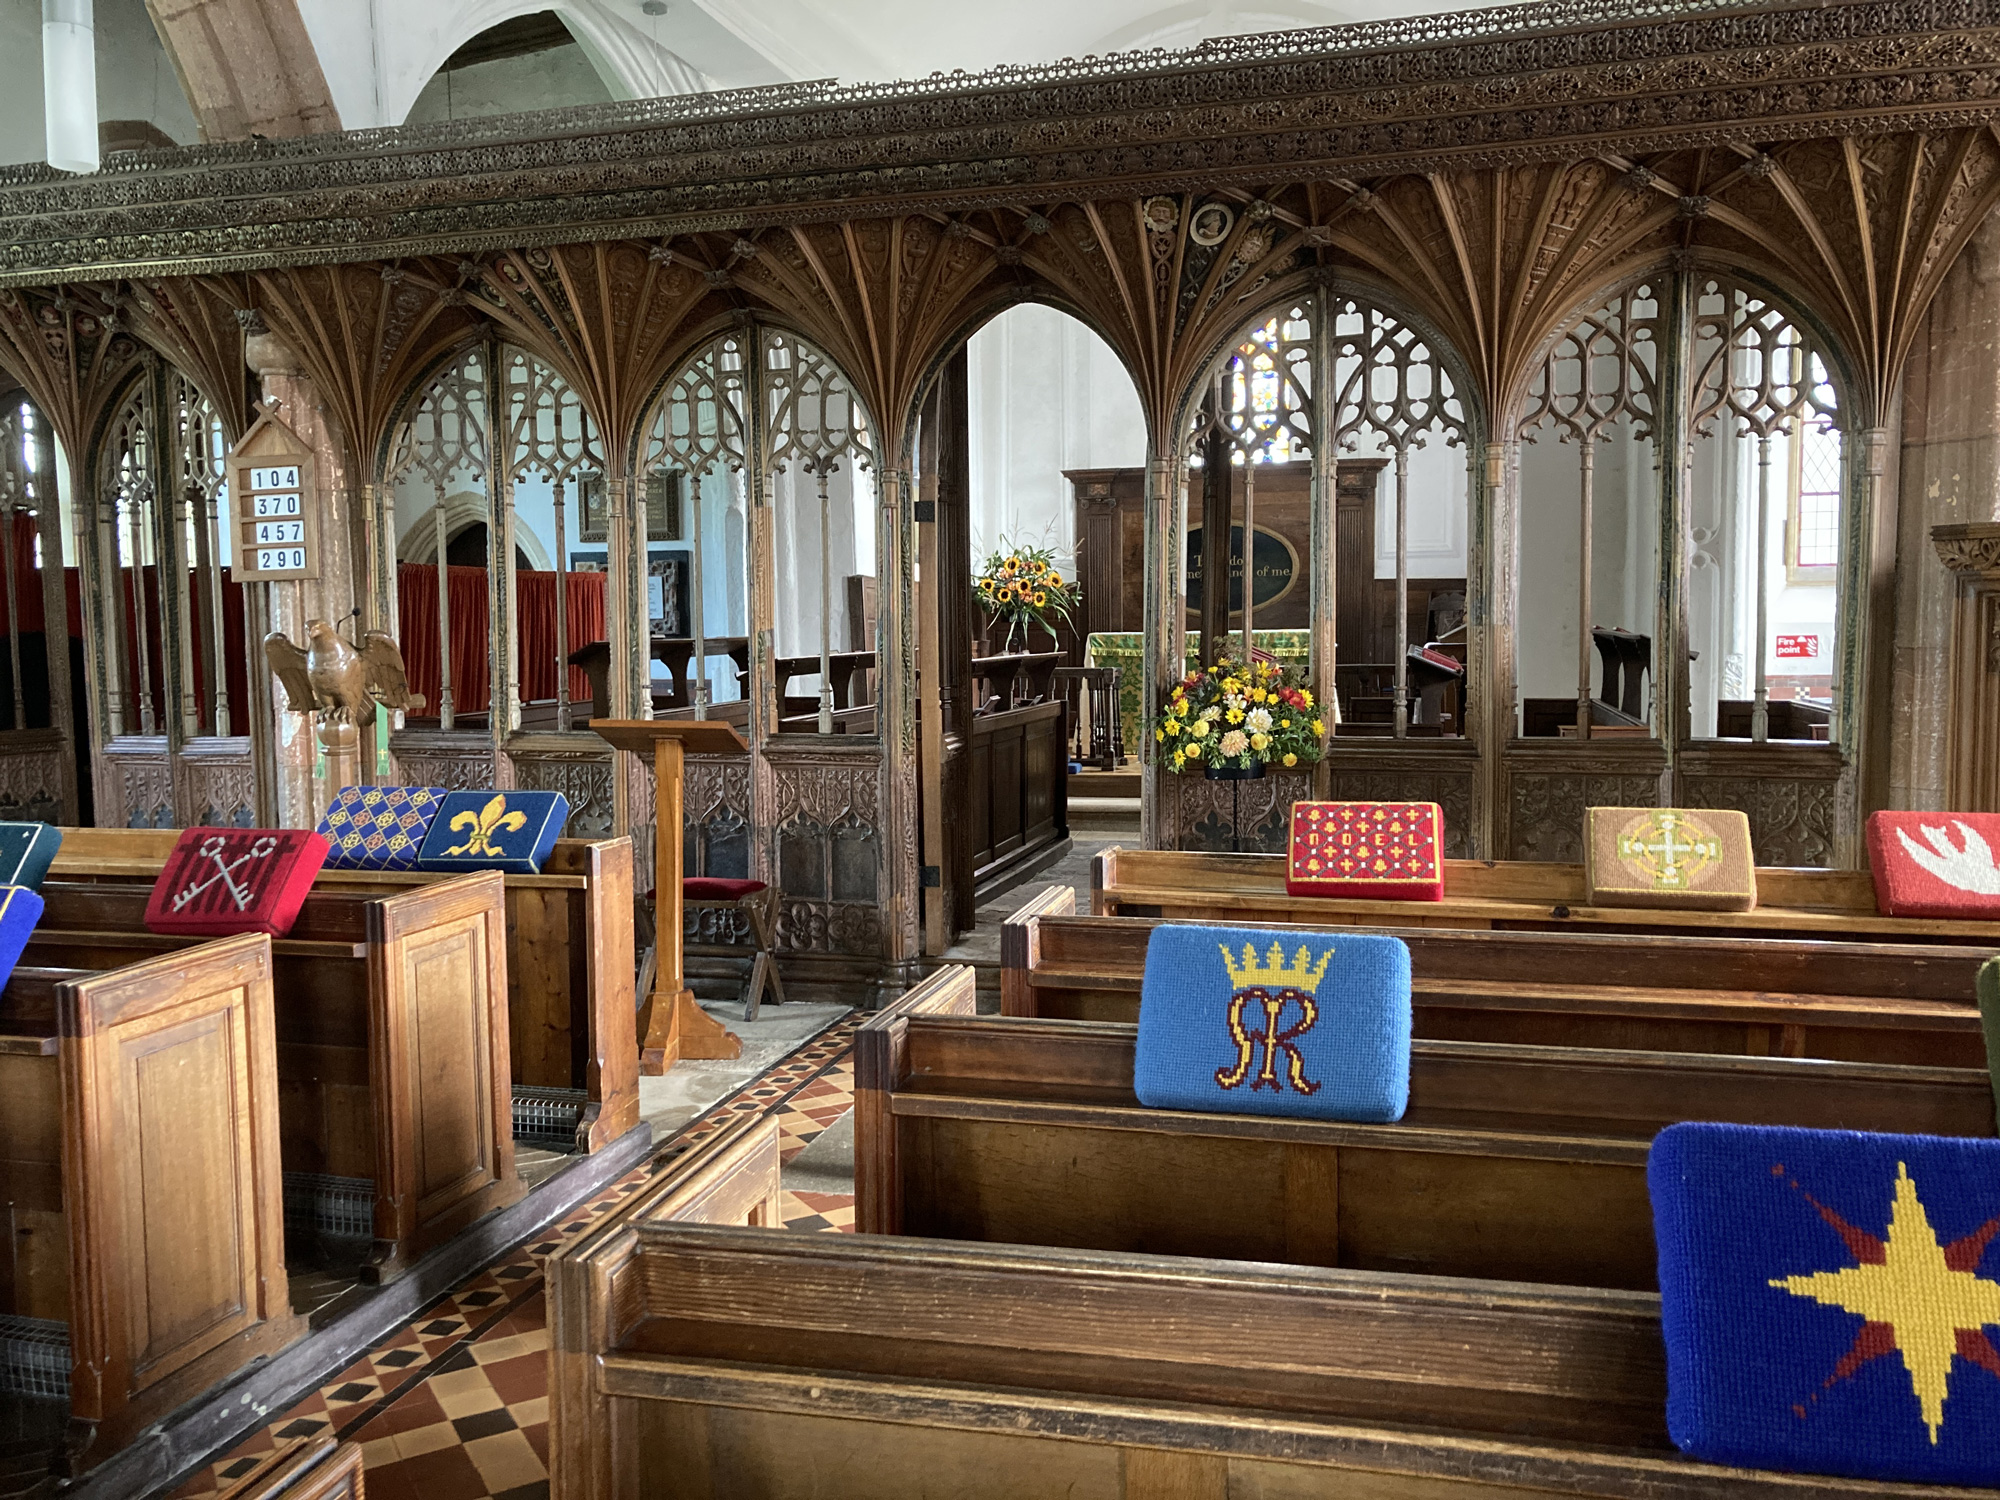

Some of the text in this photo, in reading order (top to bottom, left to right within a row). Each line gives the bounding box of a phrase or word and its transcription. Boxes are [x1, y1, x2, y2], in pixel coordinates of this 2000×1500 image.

[256, 470, 295, 488] 104
[258, 497, 296, 514] 370
[261, 524, 300, 541] 457
[262, 550, 302, 568] 290
[1256, 565, 1270, 577] of
[1778, 637, 1795, 646] Fire
[1778, 646, 1800, 656] point
